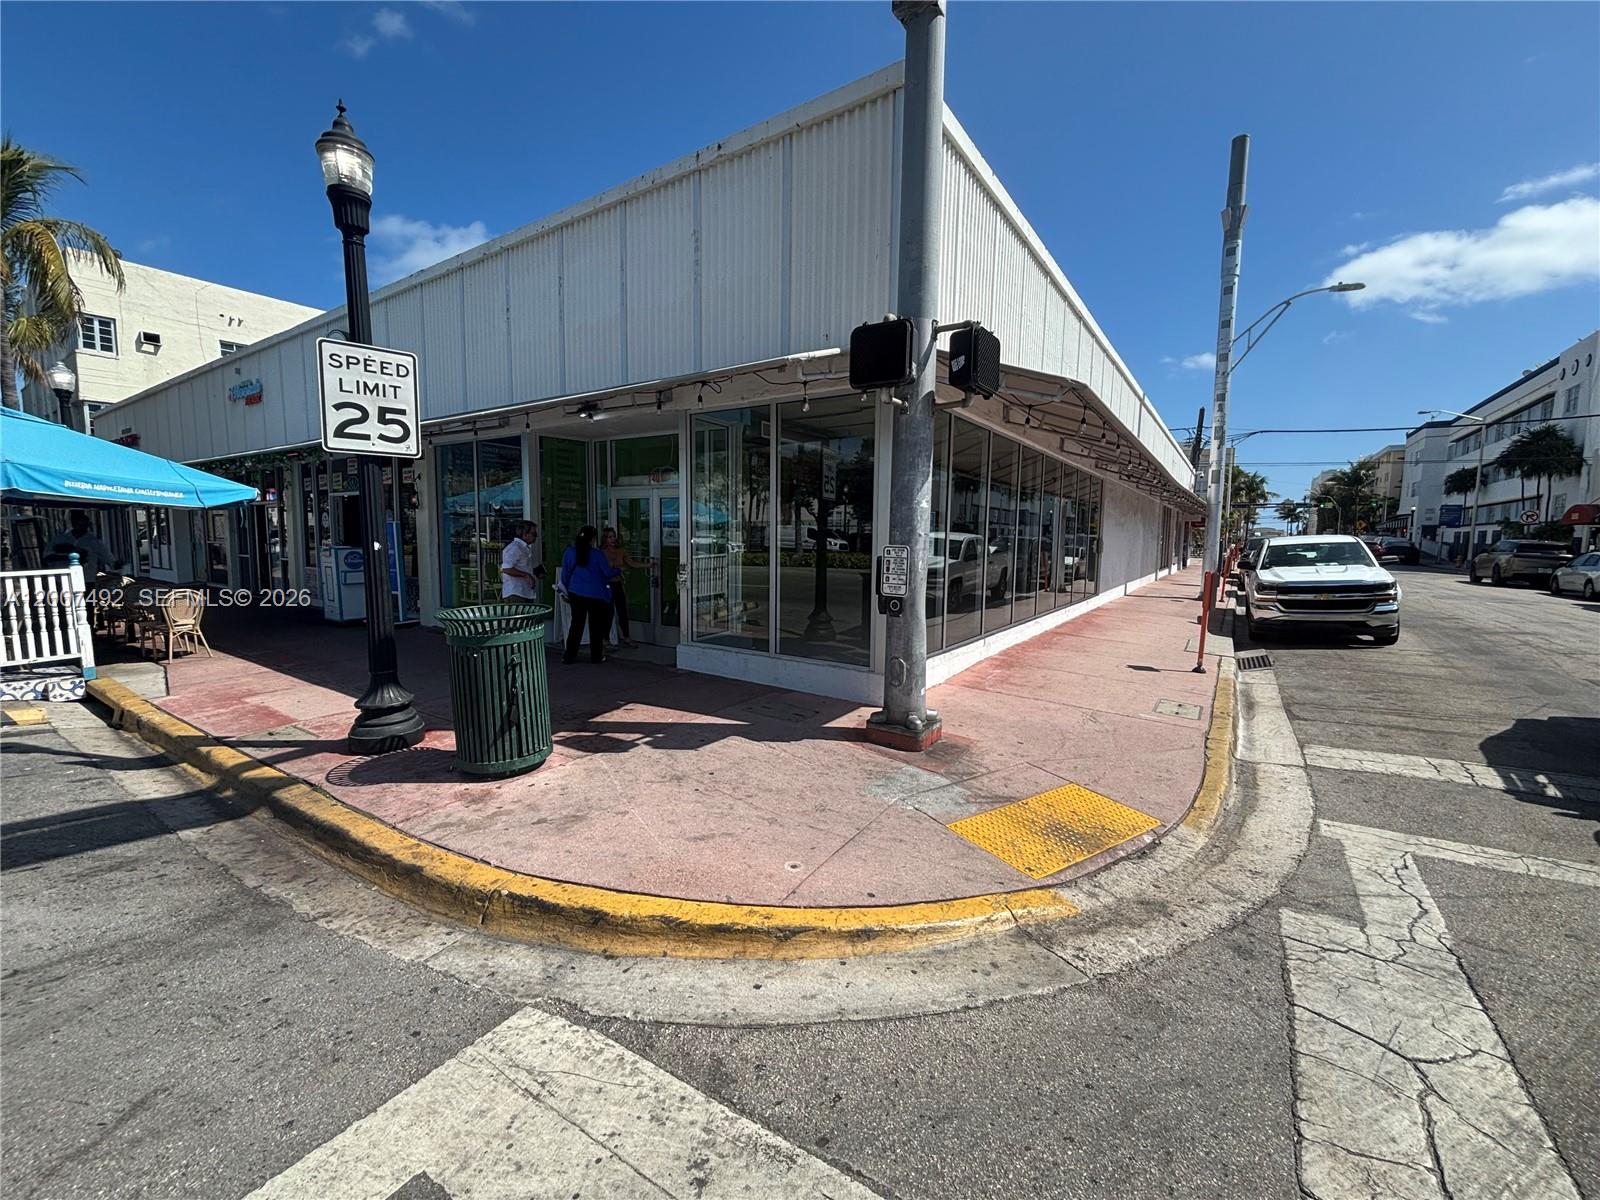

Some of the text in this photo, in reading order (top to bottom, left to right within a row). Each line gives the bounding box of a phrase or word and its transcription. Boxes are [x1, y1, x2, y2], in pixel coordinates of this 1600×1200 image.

[328, 353, 410, 378] SPEED
[339, 377, 402, 400] LIMIT
[331, 401, 411, 444] 25
